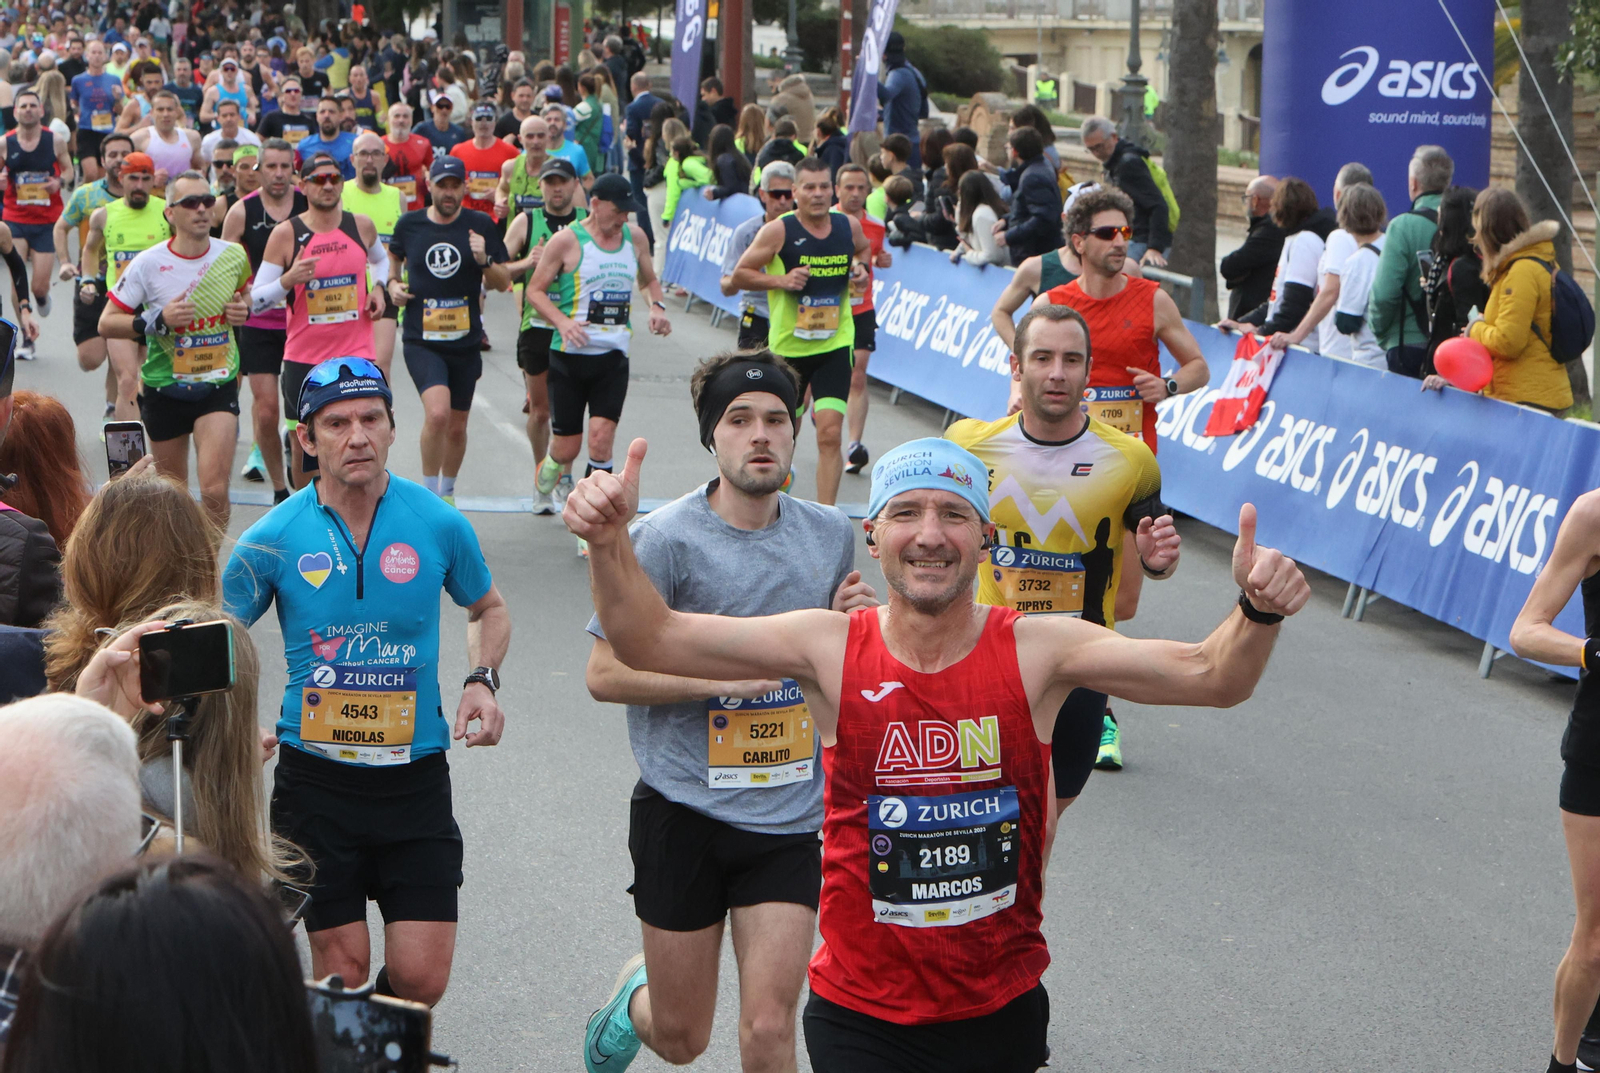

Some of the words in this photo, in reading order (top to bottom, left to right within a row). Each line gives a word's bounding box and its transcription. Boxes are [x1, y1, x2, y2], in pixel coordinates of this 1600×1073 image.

[1378, 60, 1478, 99] asics
[1368, 111, 1408, 124] sound
[1410, 111, 1440, 126] mind,
[1442, 113, 1470, 126] sound
[599, 262, 628, 270] ROYTON
[322, 276, 352, 287] ZURICH
[439, 299, 465, 307] ZURICH
[1100, 409, 1123, 418] 4709
[886, 451, 932, 470] ZURICH
[1255, 413, 1337, 496] asics
[884, 467, 932, 489] SEVILLA
[1355, 440, 1437, 531] asics
[1463, 477, 1558, 575] asics
[1021, 553, 1074, 568] ZURICH
[384, 566, 416, 574] cancer
[1018, 579, 1051, 592] 3732
[1016, 600, 1053, 611] ZIPRYS
[326, 622, 388, 637] IMAGINE
[345, 634, 416, 665] Margo
[343, 672, 404, 686] ZURICH
[751, 686, 803, 704] ZURICH
[340, 704, 378, 719] 4543
[332, 729, 385, 743] NICOLAS
[750, 721, 784, 739] 5221
[874, 715, 1001, 772] ADN
[743, 748, 790, 764] CARLITO
[917, 796, 1000, 822] ZURICH
[918, 830, 945, 838] MARATÓN
[953, 828, 973, 836] SEVILLA
[919, 844, 970, 868] 2189
[911, 876, 982, 900] MARCOS
[888, 909, 908, 917] asics
